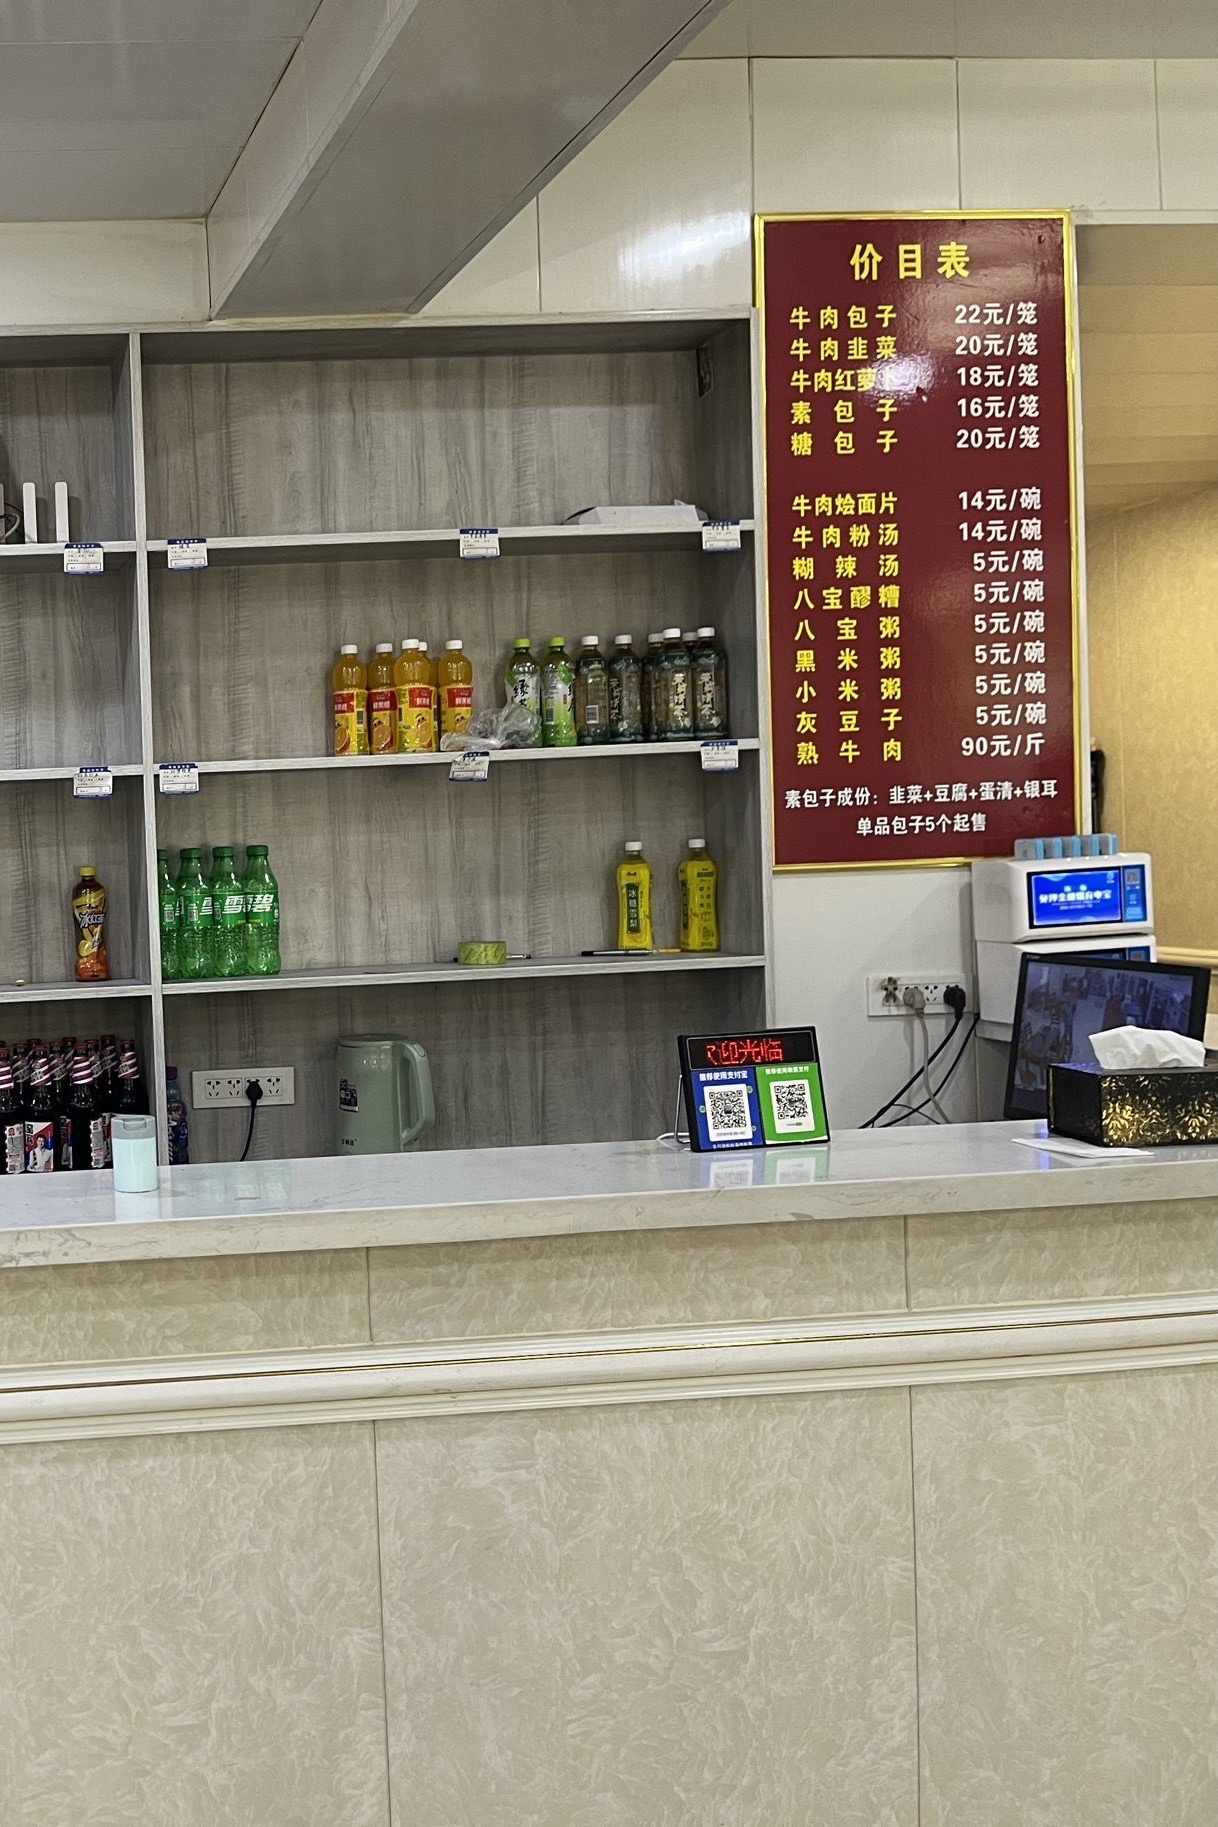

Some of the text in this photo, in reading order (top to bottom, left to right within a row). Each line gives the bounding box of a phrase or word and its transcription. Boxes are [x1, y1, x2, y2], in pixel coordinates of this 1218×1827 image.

[850, 242, 969, 280] 价目表
[790, 302, 1037, 329] 牛肉包子 22元/笼
[790, 333, 1038, 361] 牛肉韭菜 20元/笼
[957, 364, 1039, 388] 18元/笼
[791, 395, 1039, 424] 素包子 16元/笼
[791, 426, 1040, 456] 糖包子 20元/笼
[792, 487, 1041, 517] 牛肉烩面片 14元/碗
[793, 518, 1042, 548] 牛肉粉汤 14元/碗
[793, 550, 1044, 580] 糊辣汤 5元/碗
[794, 579, 1044, 610] 八宝醪糟 5元/碗
[794, 610, 1045, 641] 八宝粥 5元/碗
[795, 641, 1046, 672] 黑米粥 5元/碗
[796, 672, 1046, 703] 小米粥 5元/碗
[796, 702, 1046, 734] 灰豆子 5元/碗
[797, 733, 1045, 766] 熟牛肉 90元/斤
[857, 813, 987, 836] 单品包子5个起售
